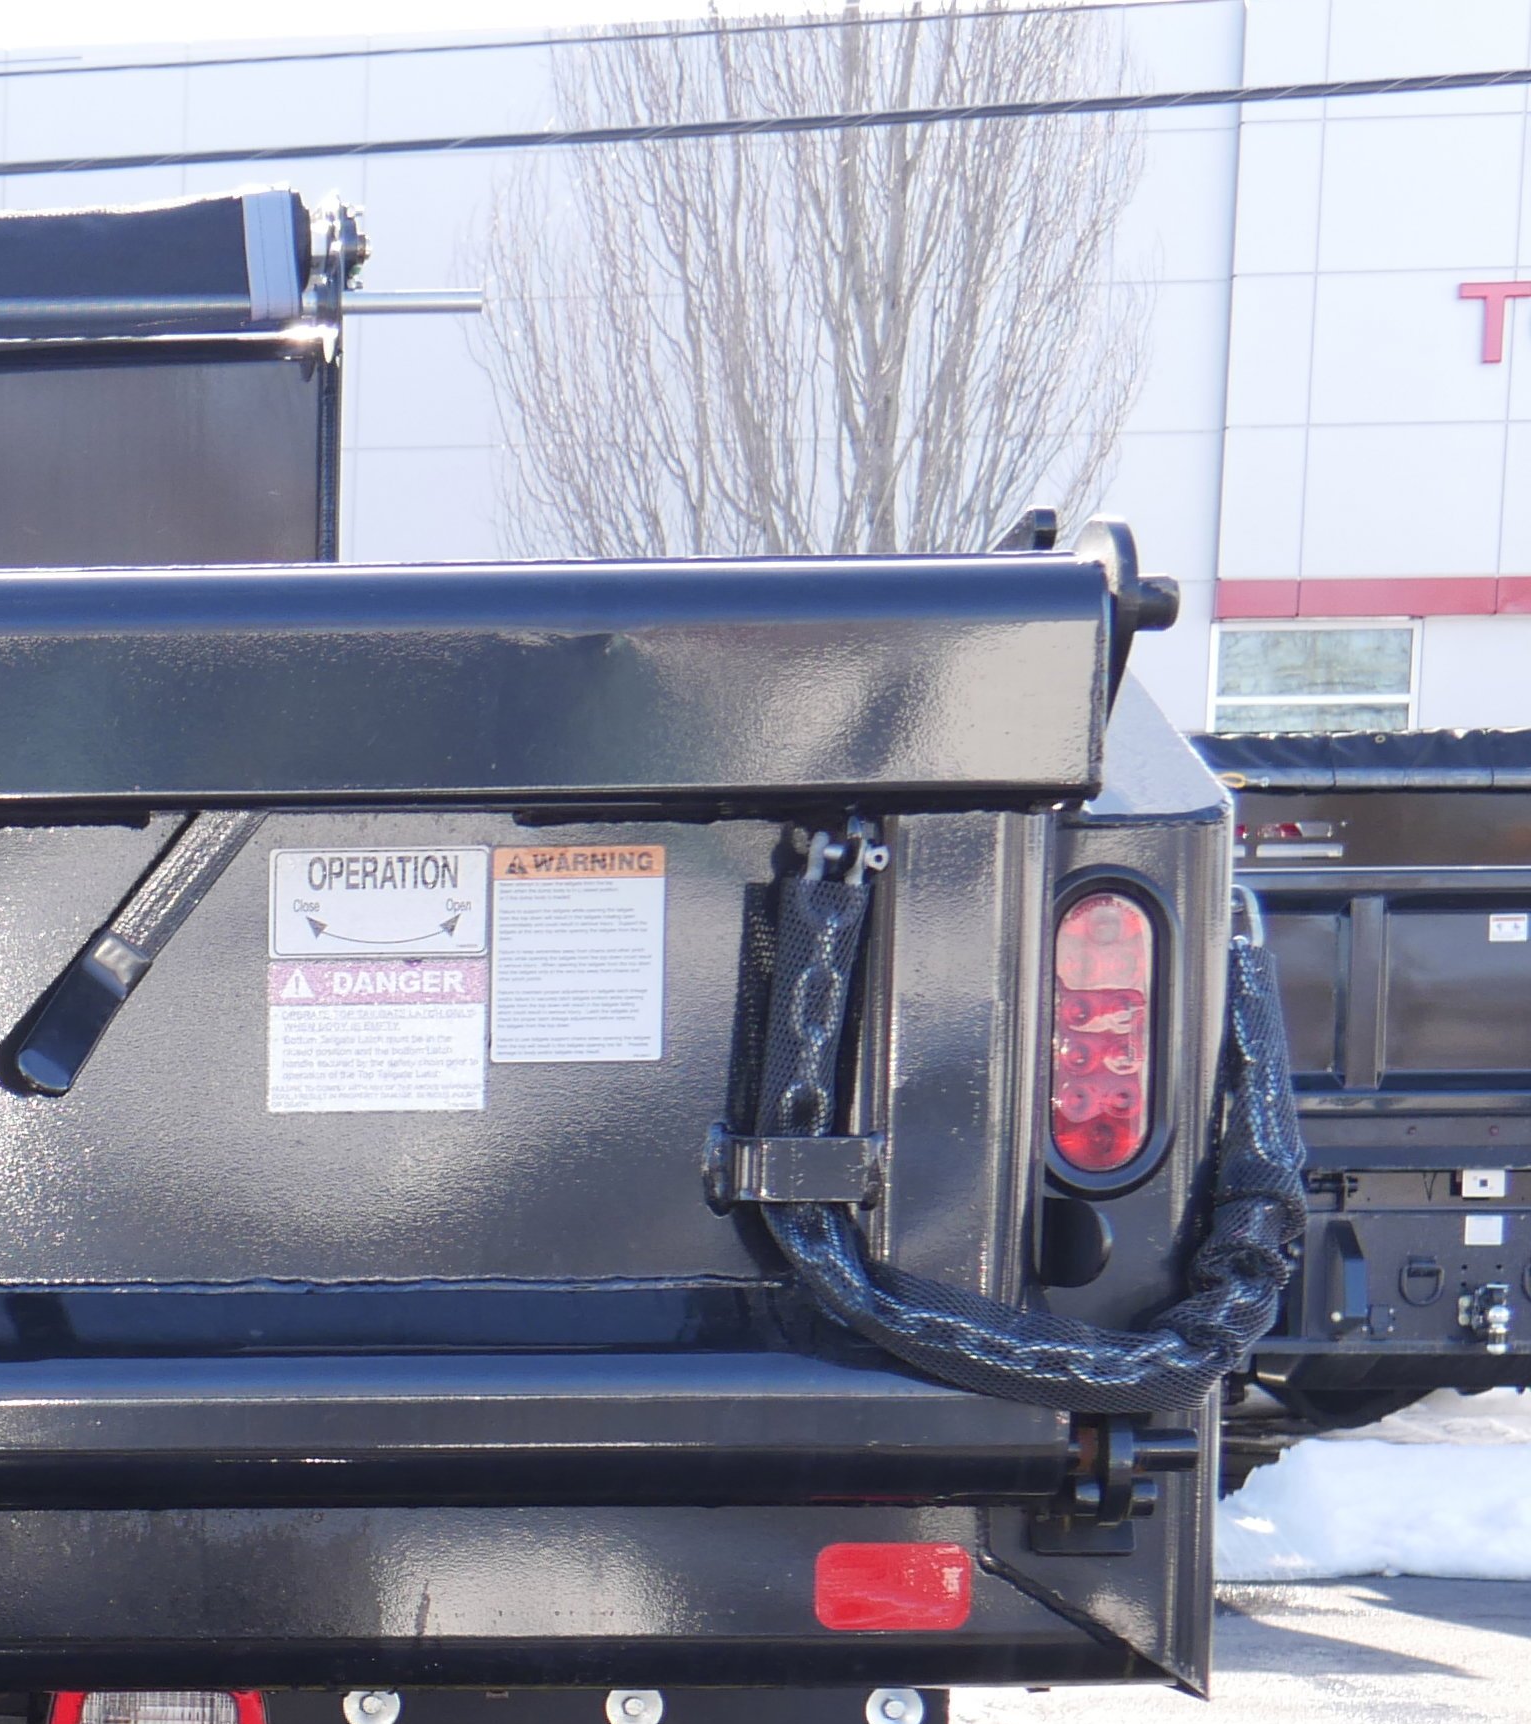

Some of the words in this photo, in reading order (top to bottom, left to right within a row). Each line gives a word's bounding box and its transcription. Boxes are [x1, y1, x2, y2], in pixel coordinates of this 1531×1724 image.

[307, 854, 459, 891] OPERATION
[533, 850, 654, 872] WARNING
[293, 898, 320, 913] Close
[445, 898, 472, 915] Open
[331, 970, 466, 995] DANGER
